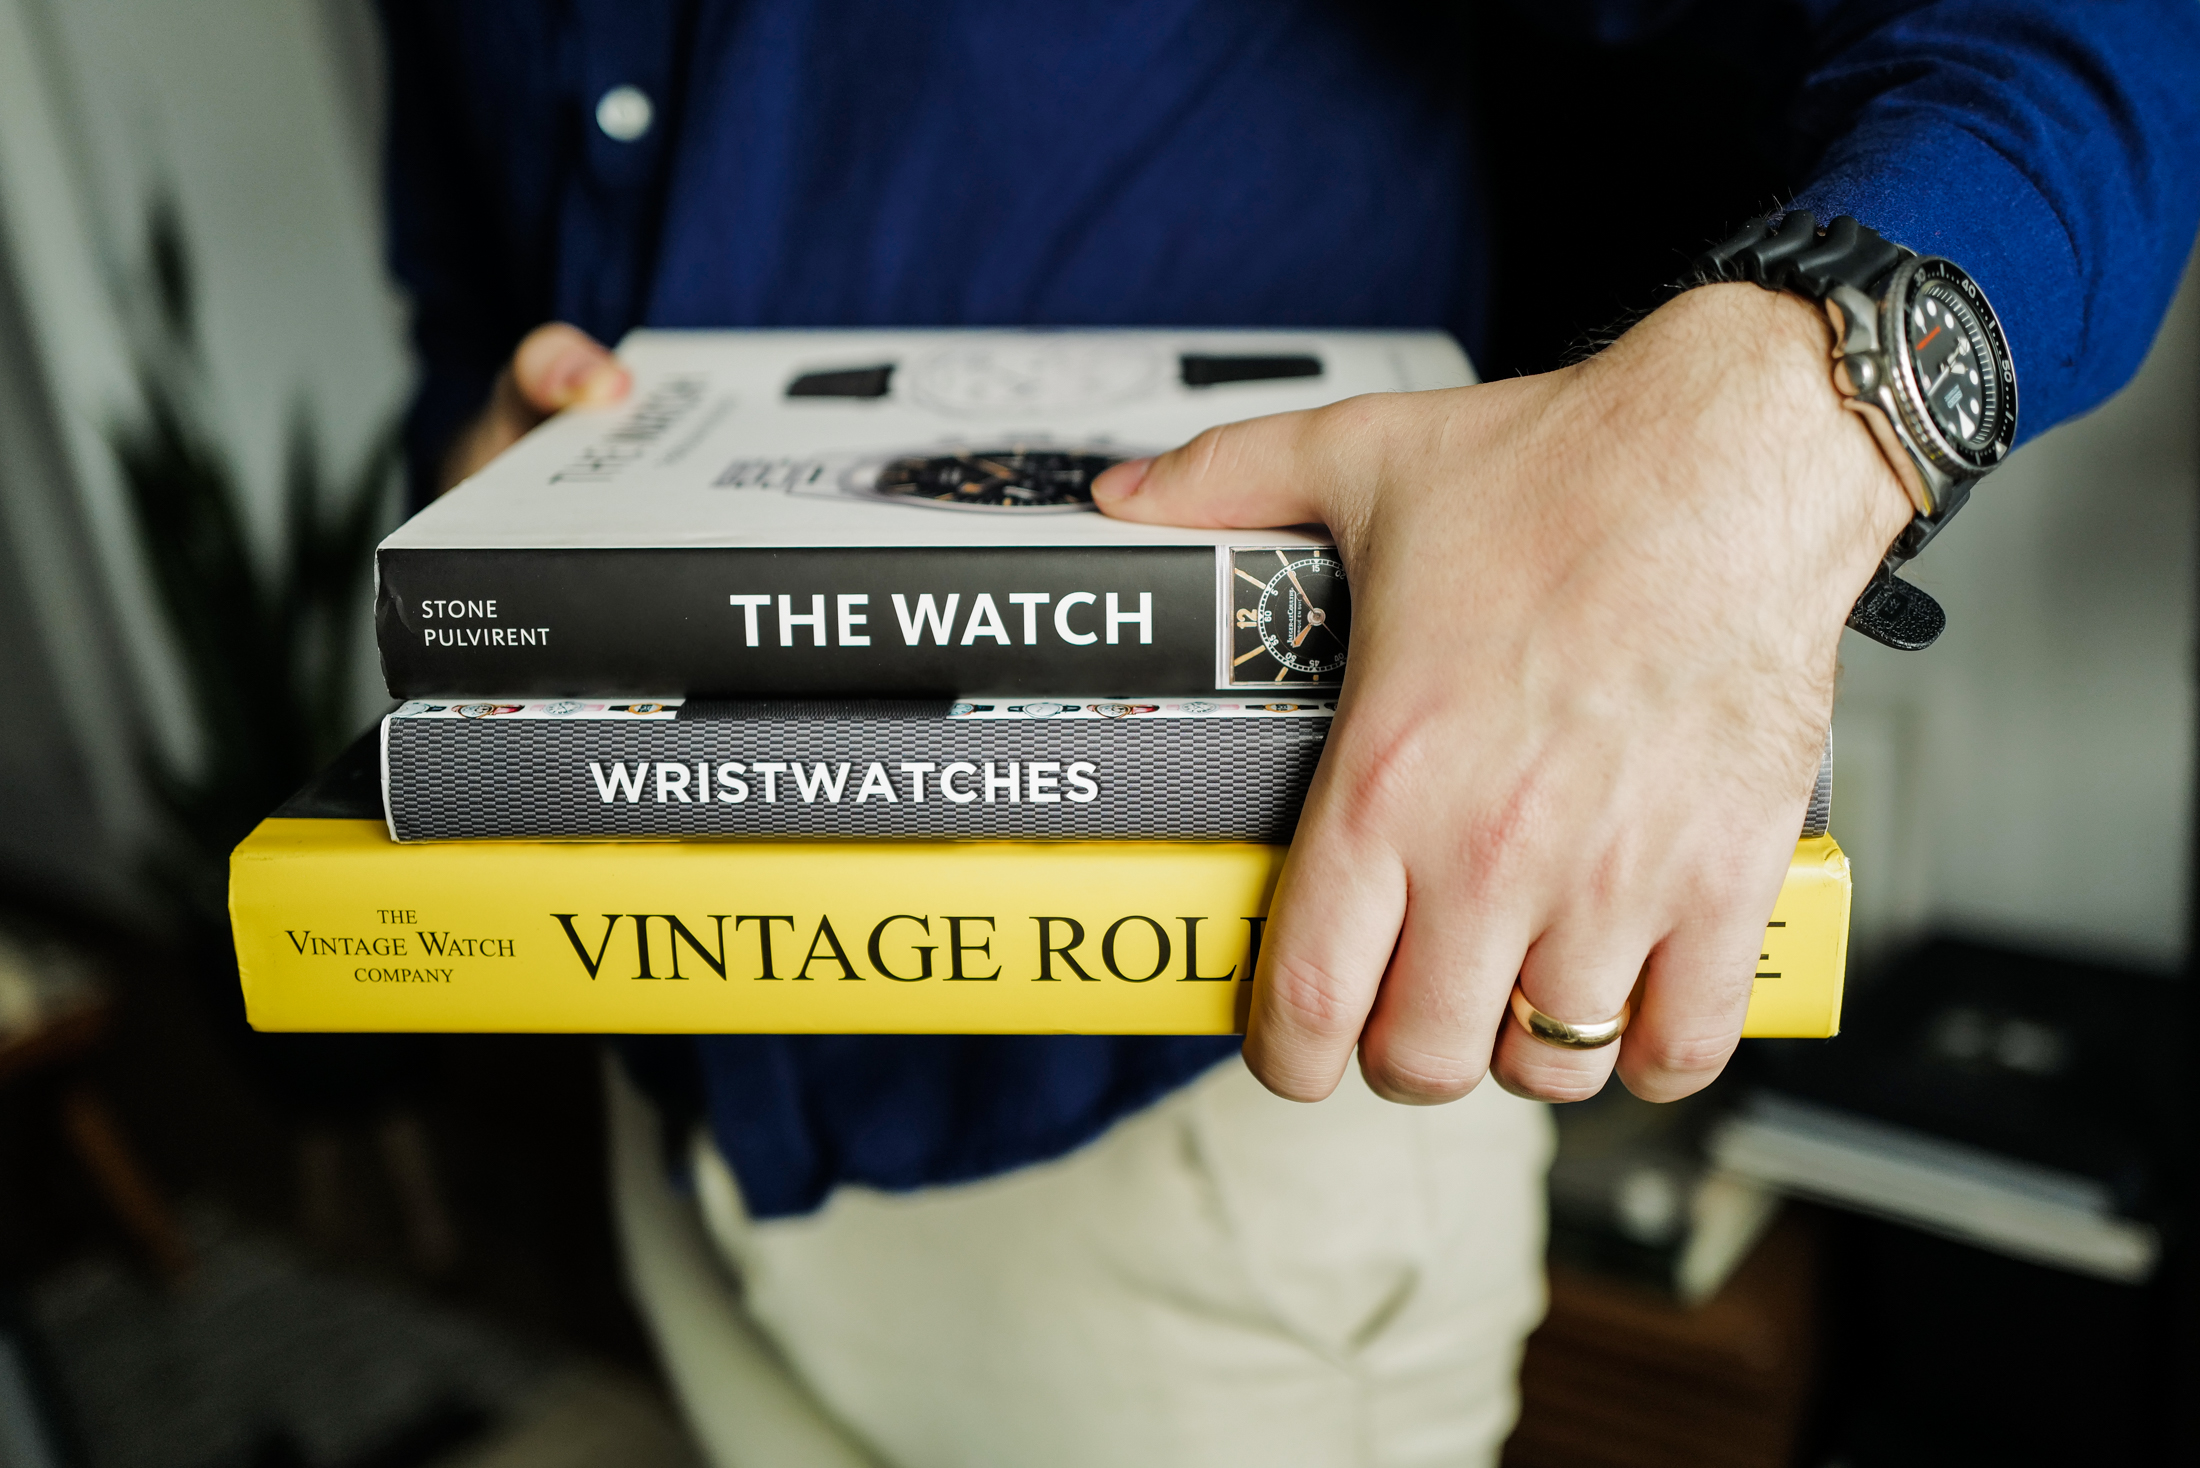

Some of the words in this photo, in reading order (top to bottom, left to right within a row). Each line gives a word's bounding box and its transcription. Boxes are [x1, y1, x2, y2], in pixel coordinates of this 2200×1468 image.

[1961, 278, 1976, 299] 40
[2001, 358, 2013, 383] 50
[1312, 564, 1320, 573] 15
[1271, 589, 1279, 597] 5
[421, 599, 498, 619] STONE
[730, 593, 871, 647] THE
[890, 590, 1153, 646] WATCH
[1236, 608, 1258, 629] 12
[1264, 610, 1272, 623] 60
[424, 627, 550, 647] PULVIRENT
[1269, 634, 1279, 647] 55
[1285, 652, 1296, 663] 50
[589, 761, 1100, 804] WRISTWATCHES
[376, 909, 418, 925] THE
[550, 913, 1002, 982] VINTAGE
[354, 968, 454, 983] COMPANY
